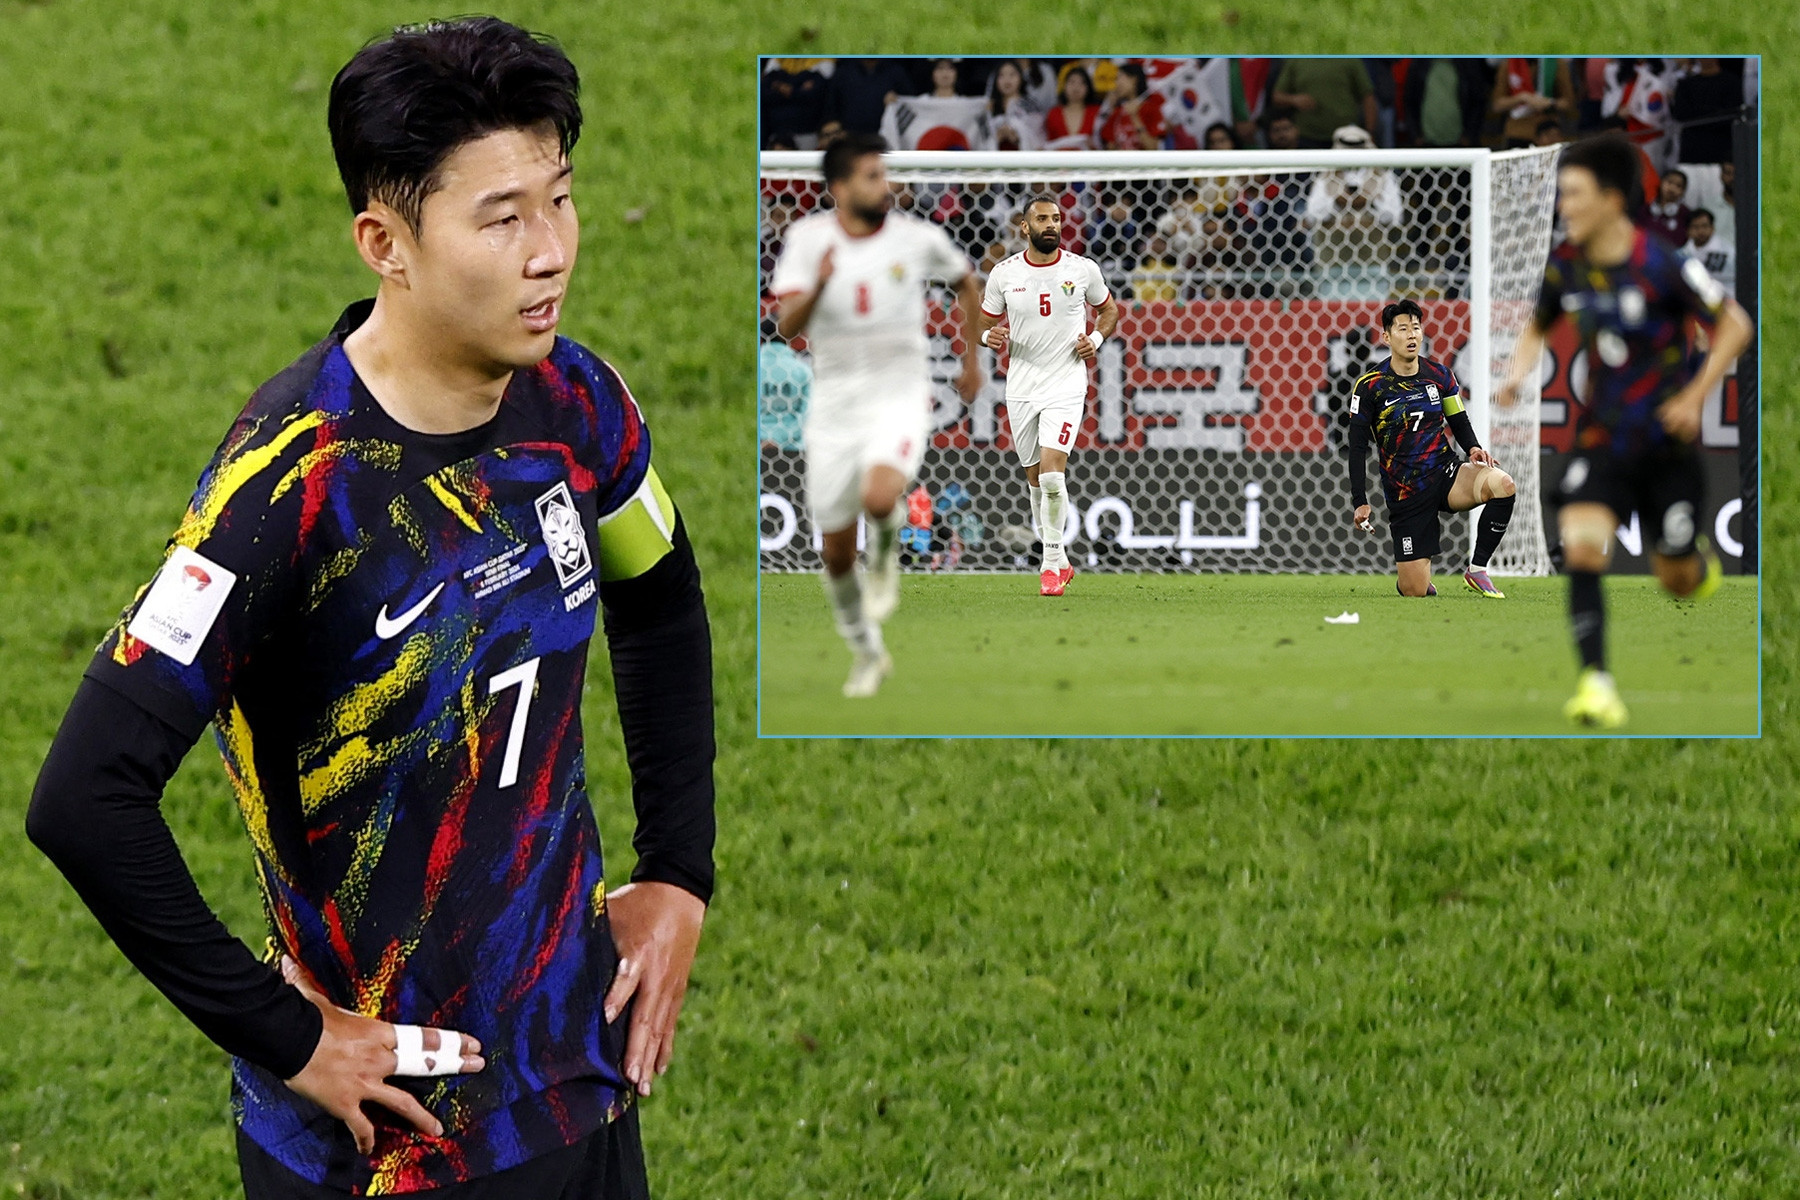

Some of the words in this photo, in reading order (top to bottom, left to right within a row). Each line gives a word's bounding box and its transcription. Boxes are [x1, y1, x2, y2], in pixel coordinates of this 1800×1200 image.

[1039, 293, 1051, 317] 5
[1058, 421, 1072, 446] 5
[1410, 411, 1424, 432] 7
[564, 578, 596, 612] KOREA
[150, 614, 173, 631] ASIAN
[173, 626, 192, 640] CUP
[488, 656, 541, 789] 7
